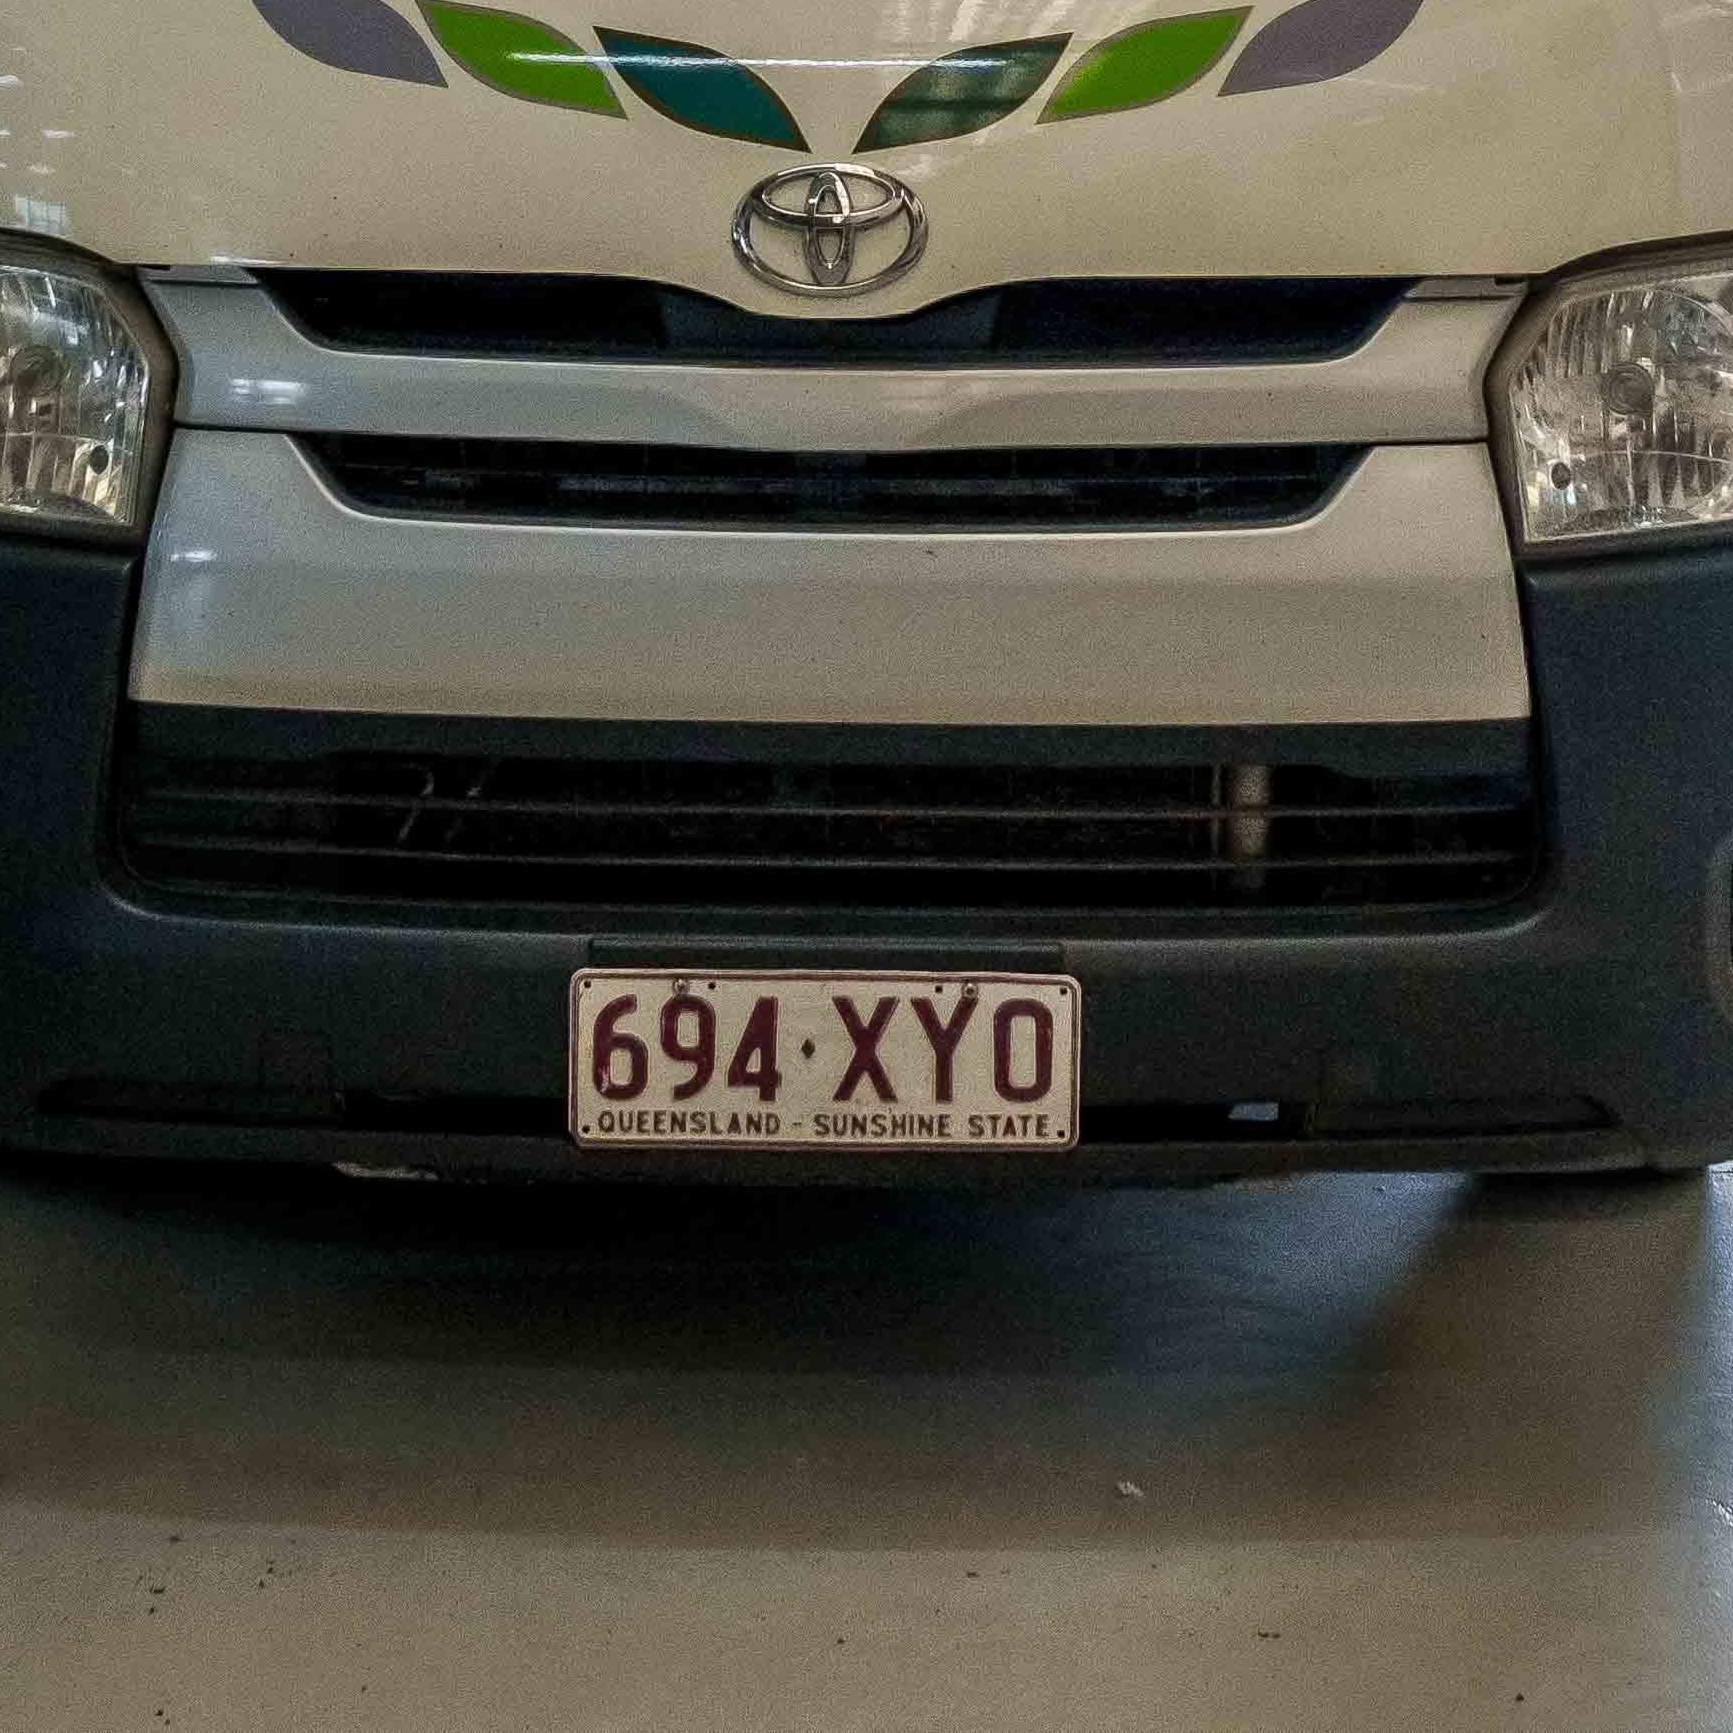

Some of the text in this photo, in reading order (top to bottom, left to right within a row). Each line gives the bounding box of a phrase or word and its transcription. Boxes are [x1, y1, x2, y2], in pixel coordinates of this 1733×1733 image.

[597, 1109, 782, 1139] QUEENSLAND
[813, 1111, 950, 1140] SUNSHINE
[968, 1113, 1050, 1139] STATE
